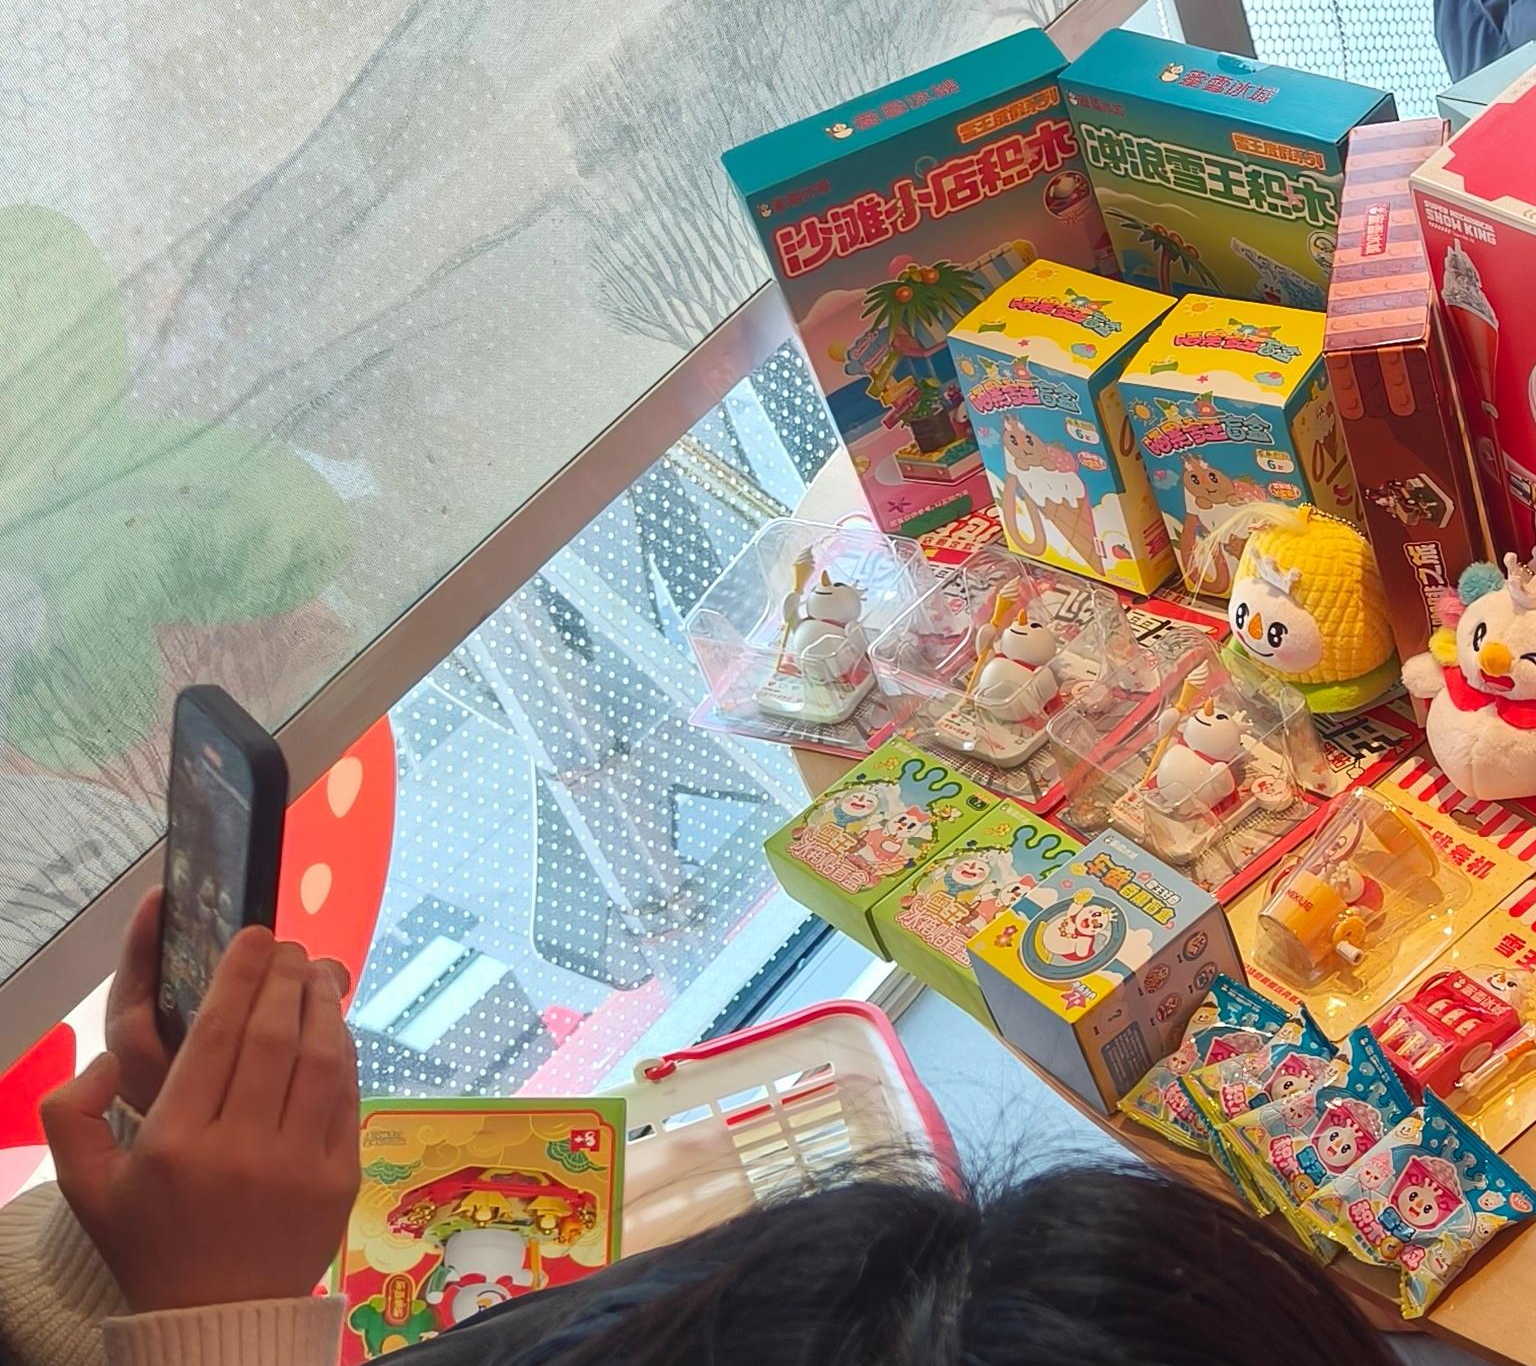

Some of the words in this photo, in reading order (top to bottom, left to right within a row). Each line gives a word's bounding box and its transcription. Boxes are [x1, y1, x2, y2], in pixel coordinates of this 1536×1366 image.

[1178, 69, 1281, 106] 蜜雪冰城
[776, 121, 1079, 278] 沙滩小店积木
[1080, 123, 1340, 227] 冲浪雪王积木
[1426, 210, 1463, 234] SNOW
[1463, 222, 1497, 246] KING
[786, 839, 870, 894] 冰箱贴盲盒
